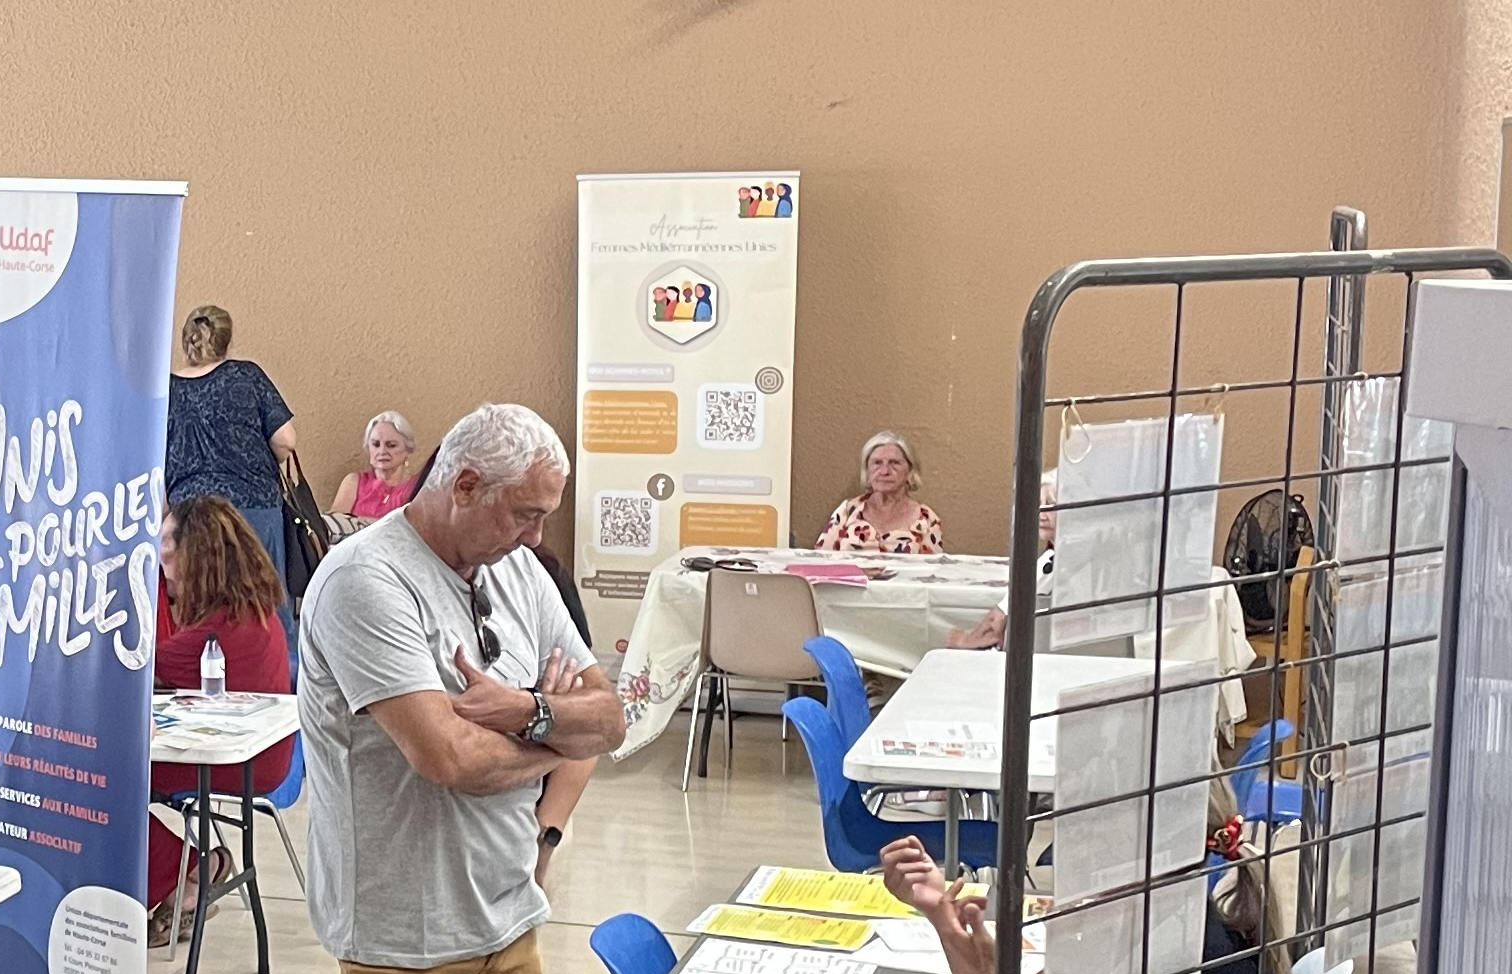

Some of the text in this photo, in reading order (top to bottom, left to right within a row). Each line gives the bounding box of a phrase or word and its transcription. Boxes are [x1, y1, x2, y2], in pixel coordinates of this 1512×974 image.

[650, 213, 719, 240] Association
[591, 242, 637, 253] Femmes
[5, 466, 164, 583] POUR LES
[34, 724, 51, 739] DES
[53, 728, 98, 749] FAMILLES
[3, 752, 31, 770] LEURS
[32, 758, 75, 782] RÉALITÉS
[75, 769, 89, 784] DE
[90, 773, 107, 788] VIE
[0, 785, 41, 808] SERVICES
[42, 797, 62, 813] AUX
[63, 802, 109, 826] FAMILLES
[28, 829, 83, 855] ASSOCIATIF
